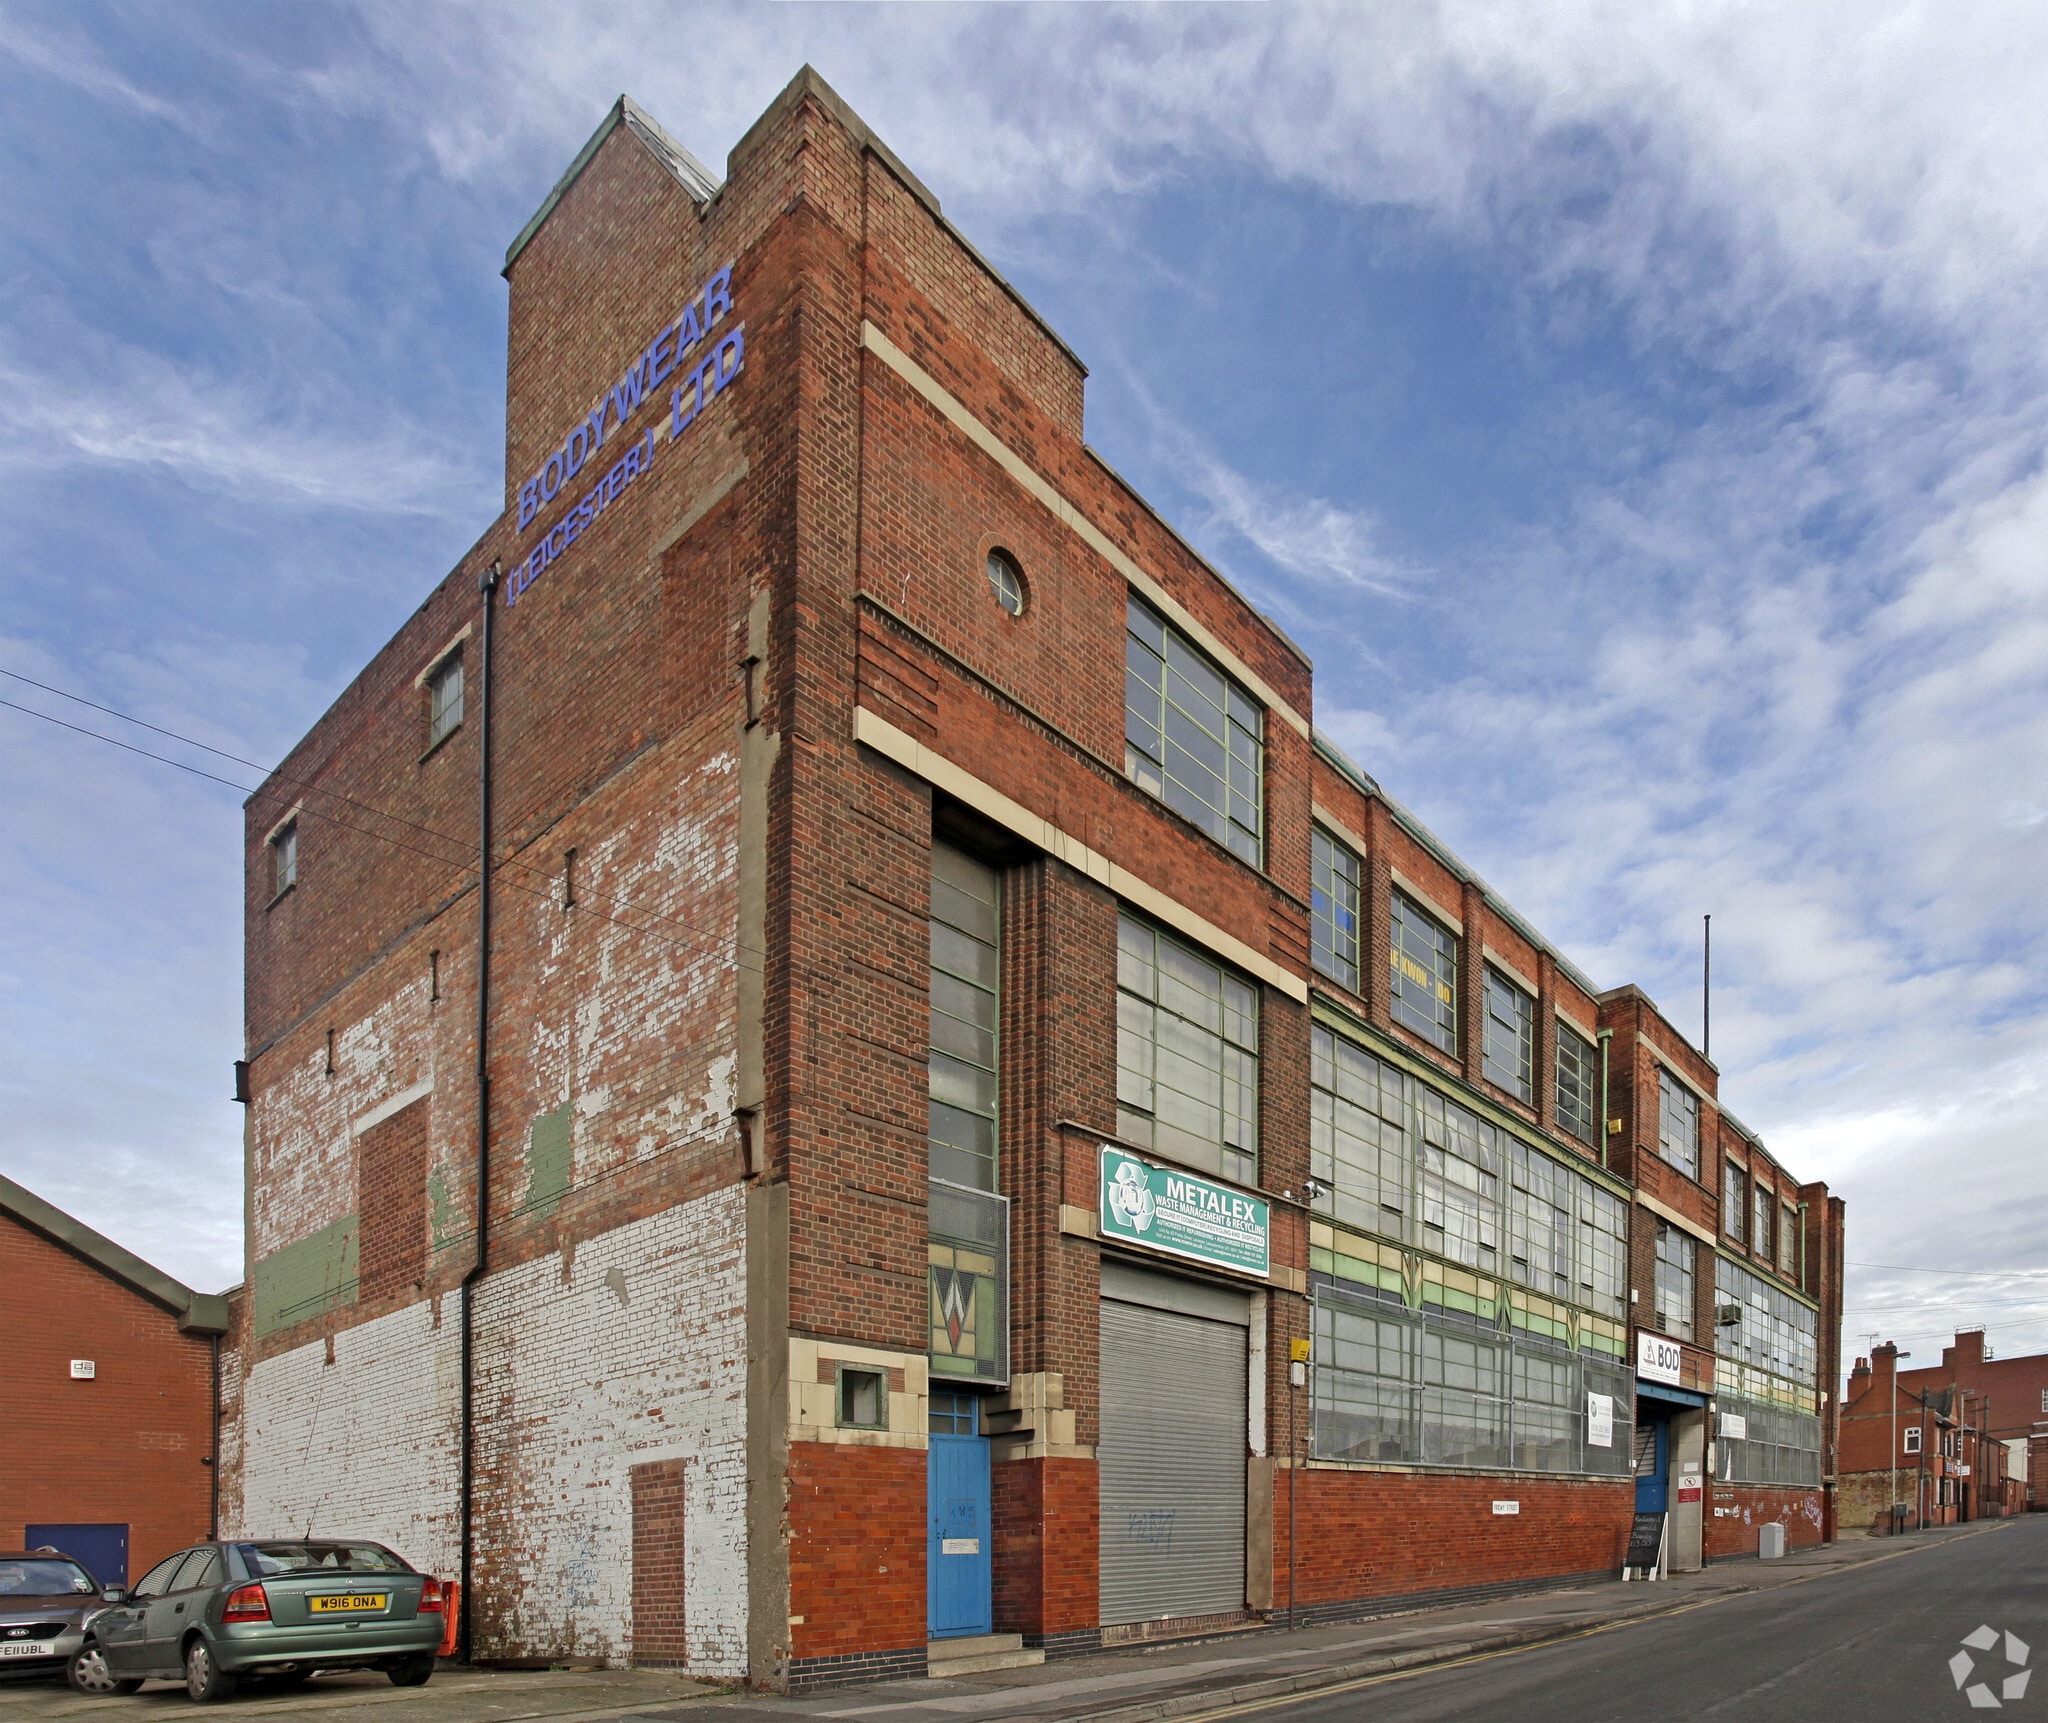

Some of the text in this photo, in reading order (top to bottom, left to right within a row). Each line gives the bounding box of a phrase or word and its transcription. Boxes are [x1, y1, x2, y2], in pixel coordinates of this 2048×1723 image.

[517, 264, 734, 533] BODYWEAR
[506, 329, 745, 608] (LEICESTER) LTD
[1156, 1194, 1265, 1236] WASTE MANAGEMENT & RECYCLING
[1167, 1177, 1256, 1223] METALEX
[1158, 1210, 1175, 1220] SECURE
[1242, 1234, 1264, 1245] DISPOSALS
[321, 1596, 377, 1609] W916 ONA
